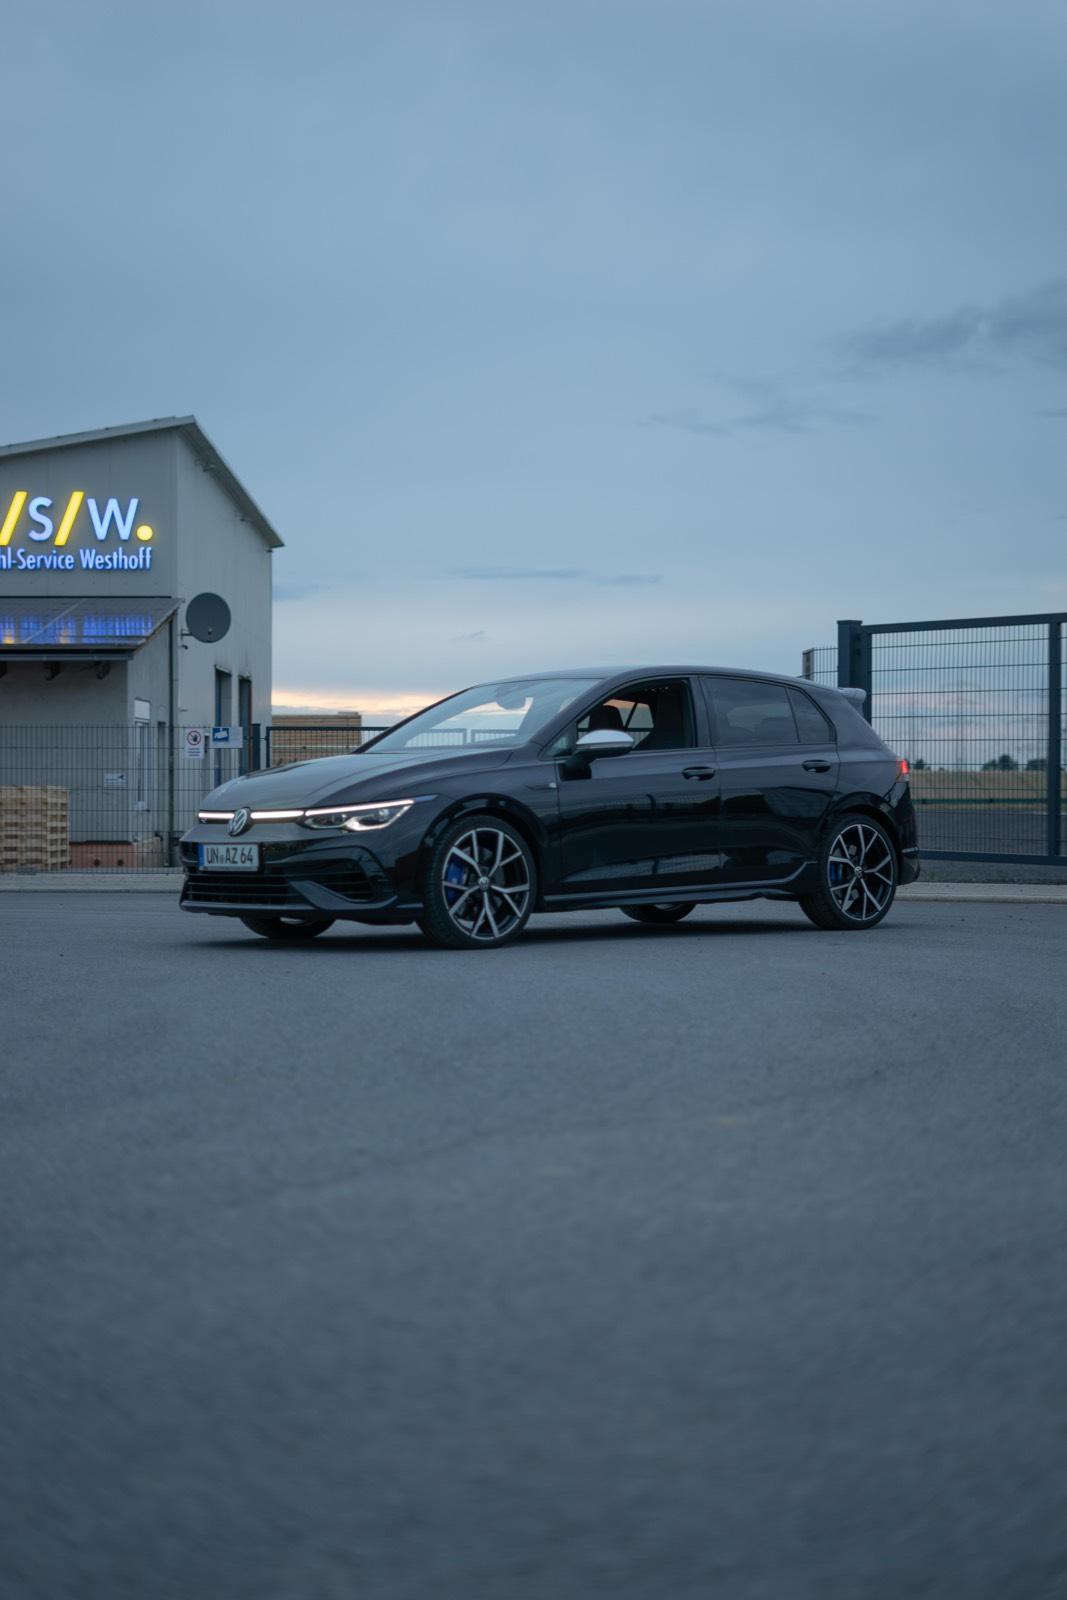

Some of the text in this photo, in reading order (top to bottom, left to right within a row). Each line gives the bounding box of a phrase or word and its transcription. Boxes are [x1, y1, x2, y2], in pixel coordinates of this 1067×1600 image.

[79, 546, 152, 570] Westhoff
[225, 847, 238, 864] AZ
[240, 847, 253, 864] 64
